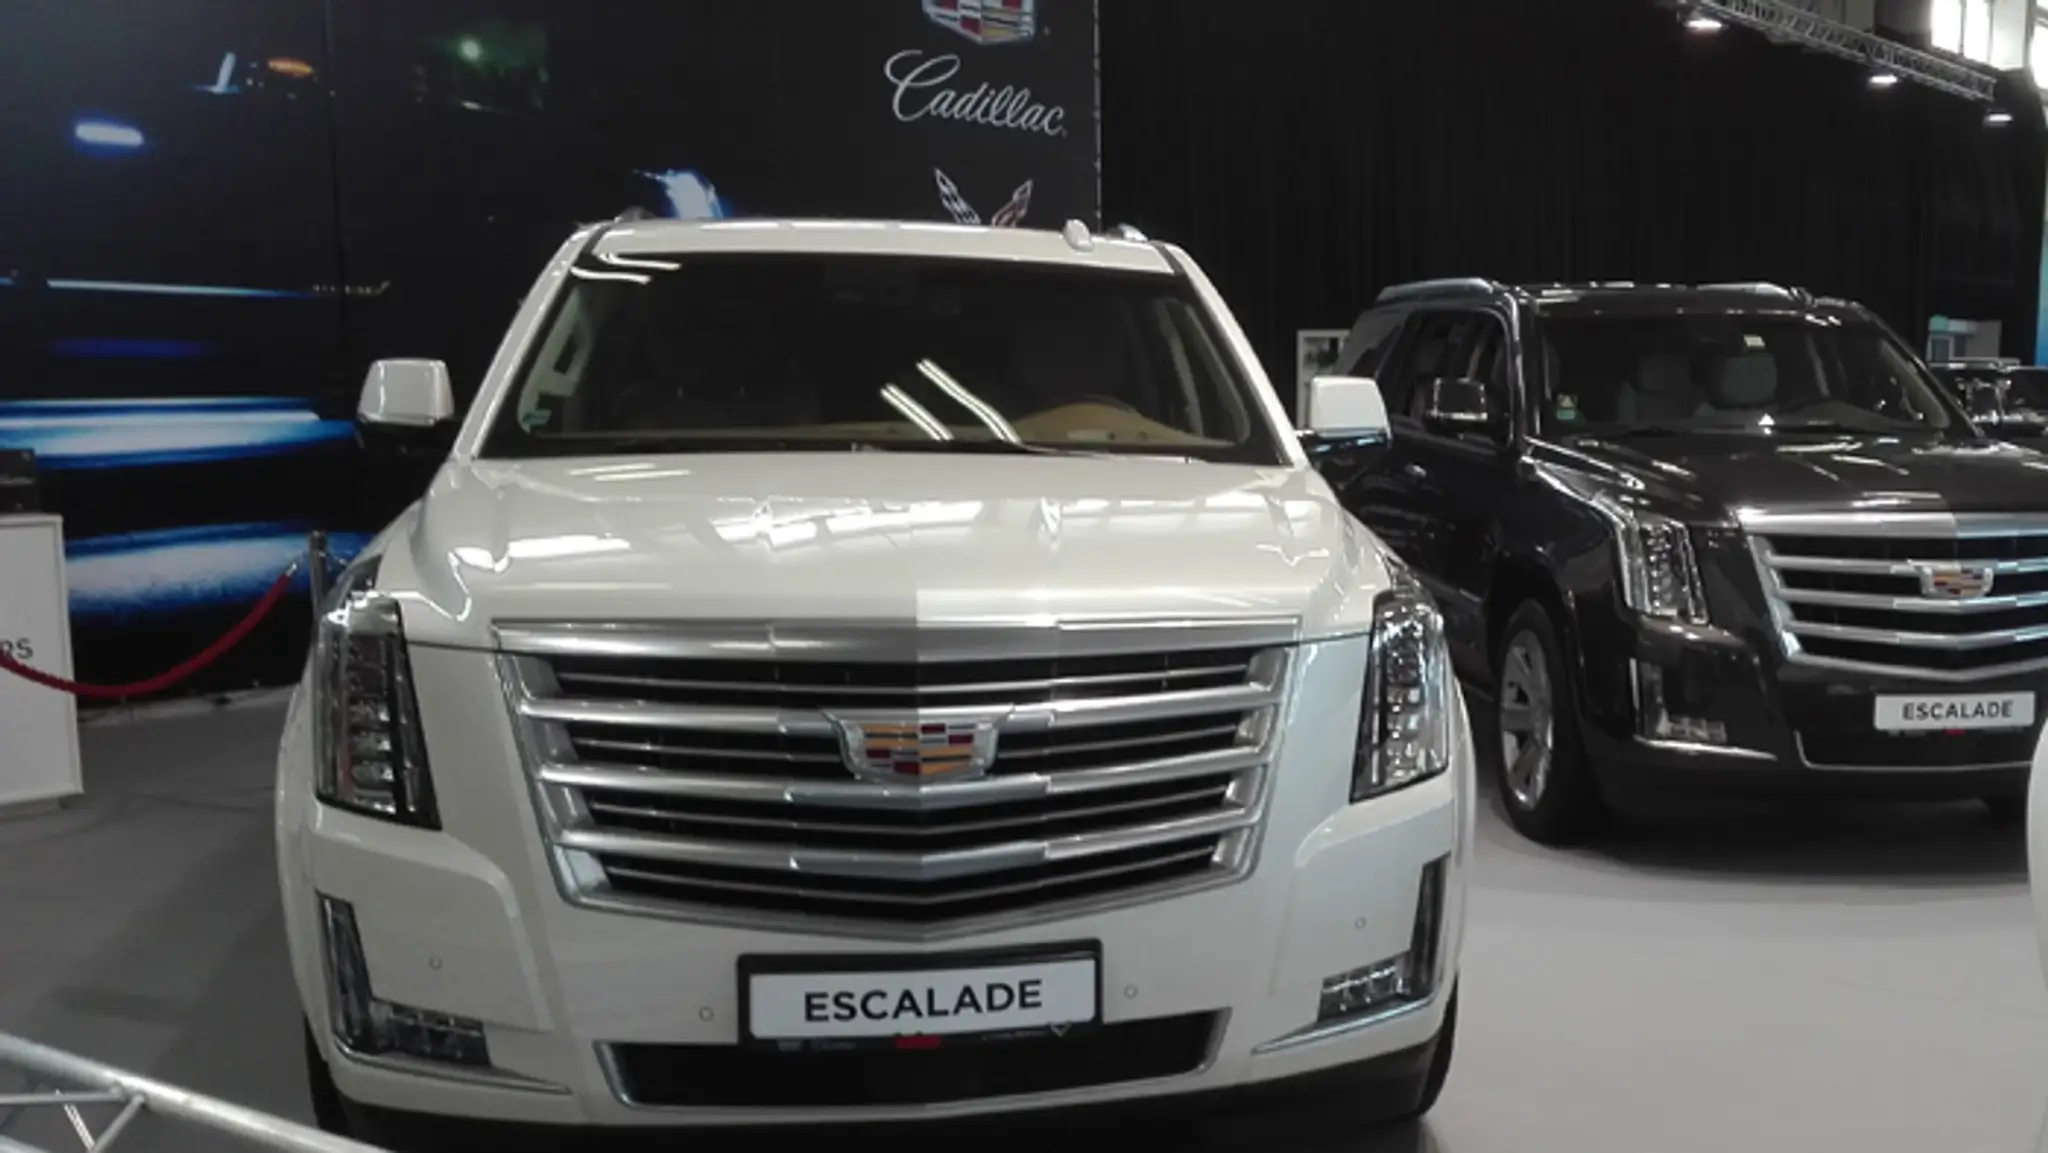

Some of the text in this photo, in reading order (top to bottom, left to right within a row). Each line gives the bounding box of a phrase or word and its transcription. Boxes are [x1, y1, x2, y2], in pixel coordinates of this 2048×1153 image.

[884, 49, 1066, 136] Cadillac
[1902, 700, 2014, 721] ESCALADE
[804, 979, 1043, 1022] ESCALADE
